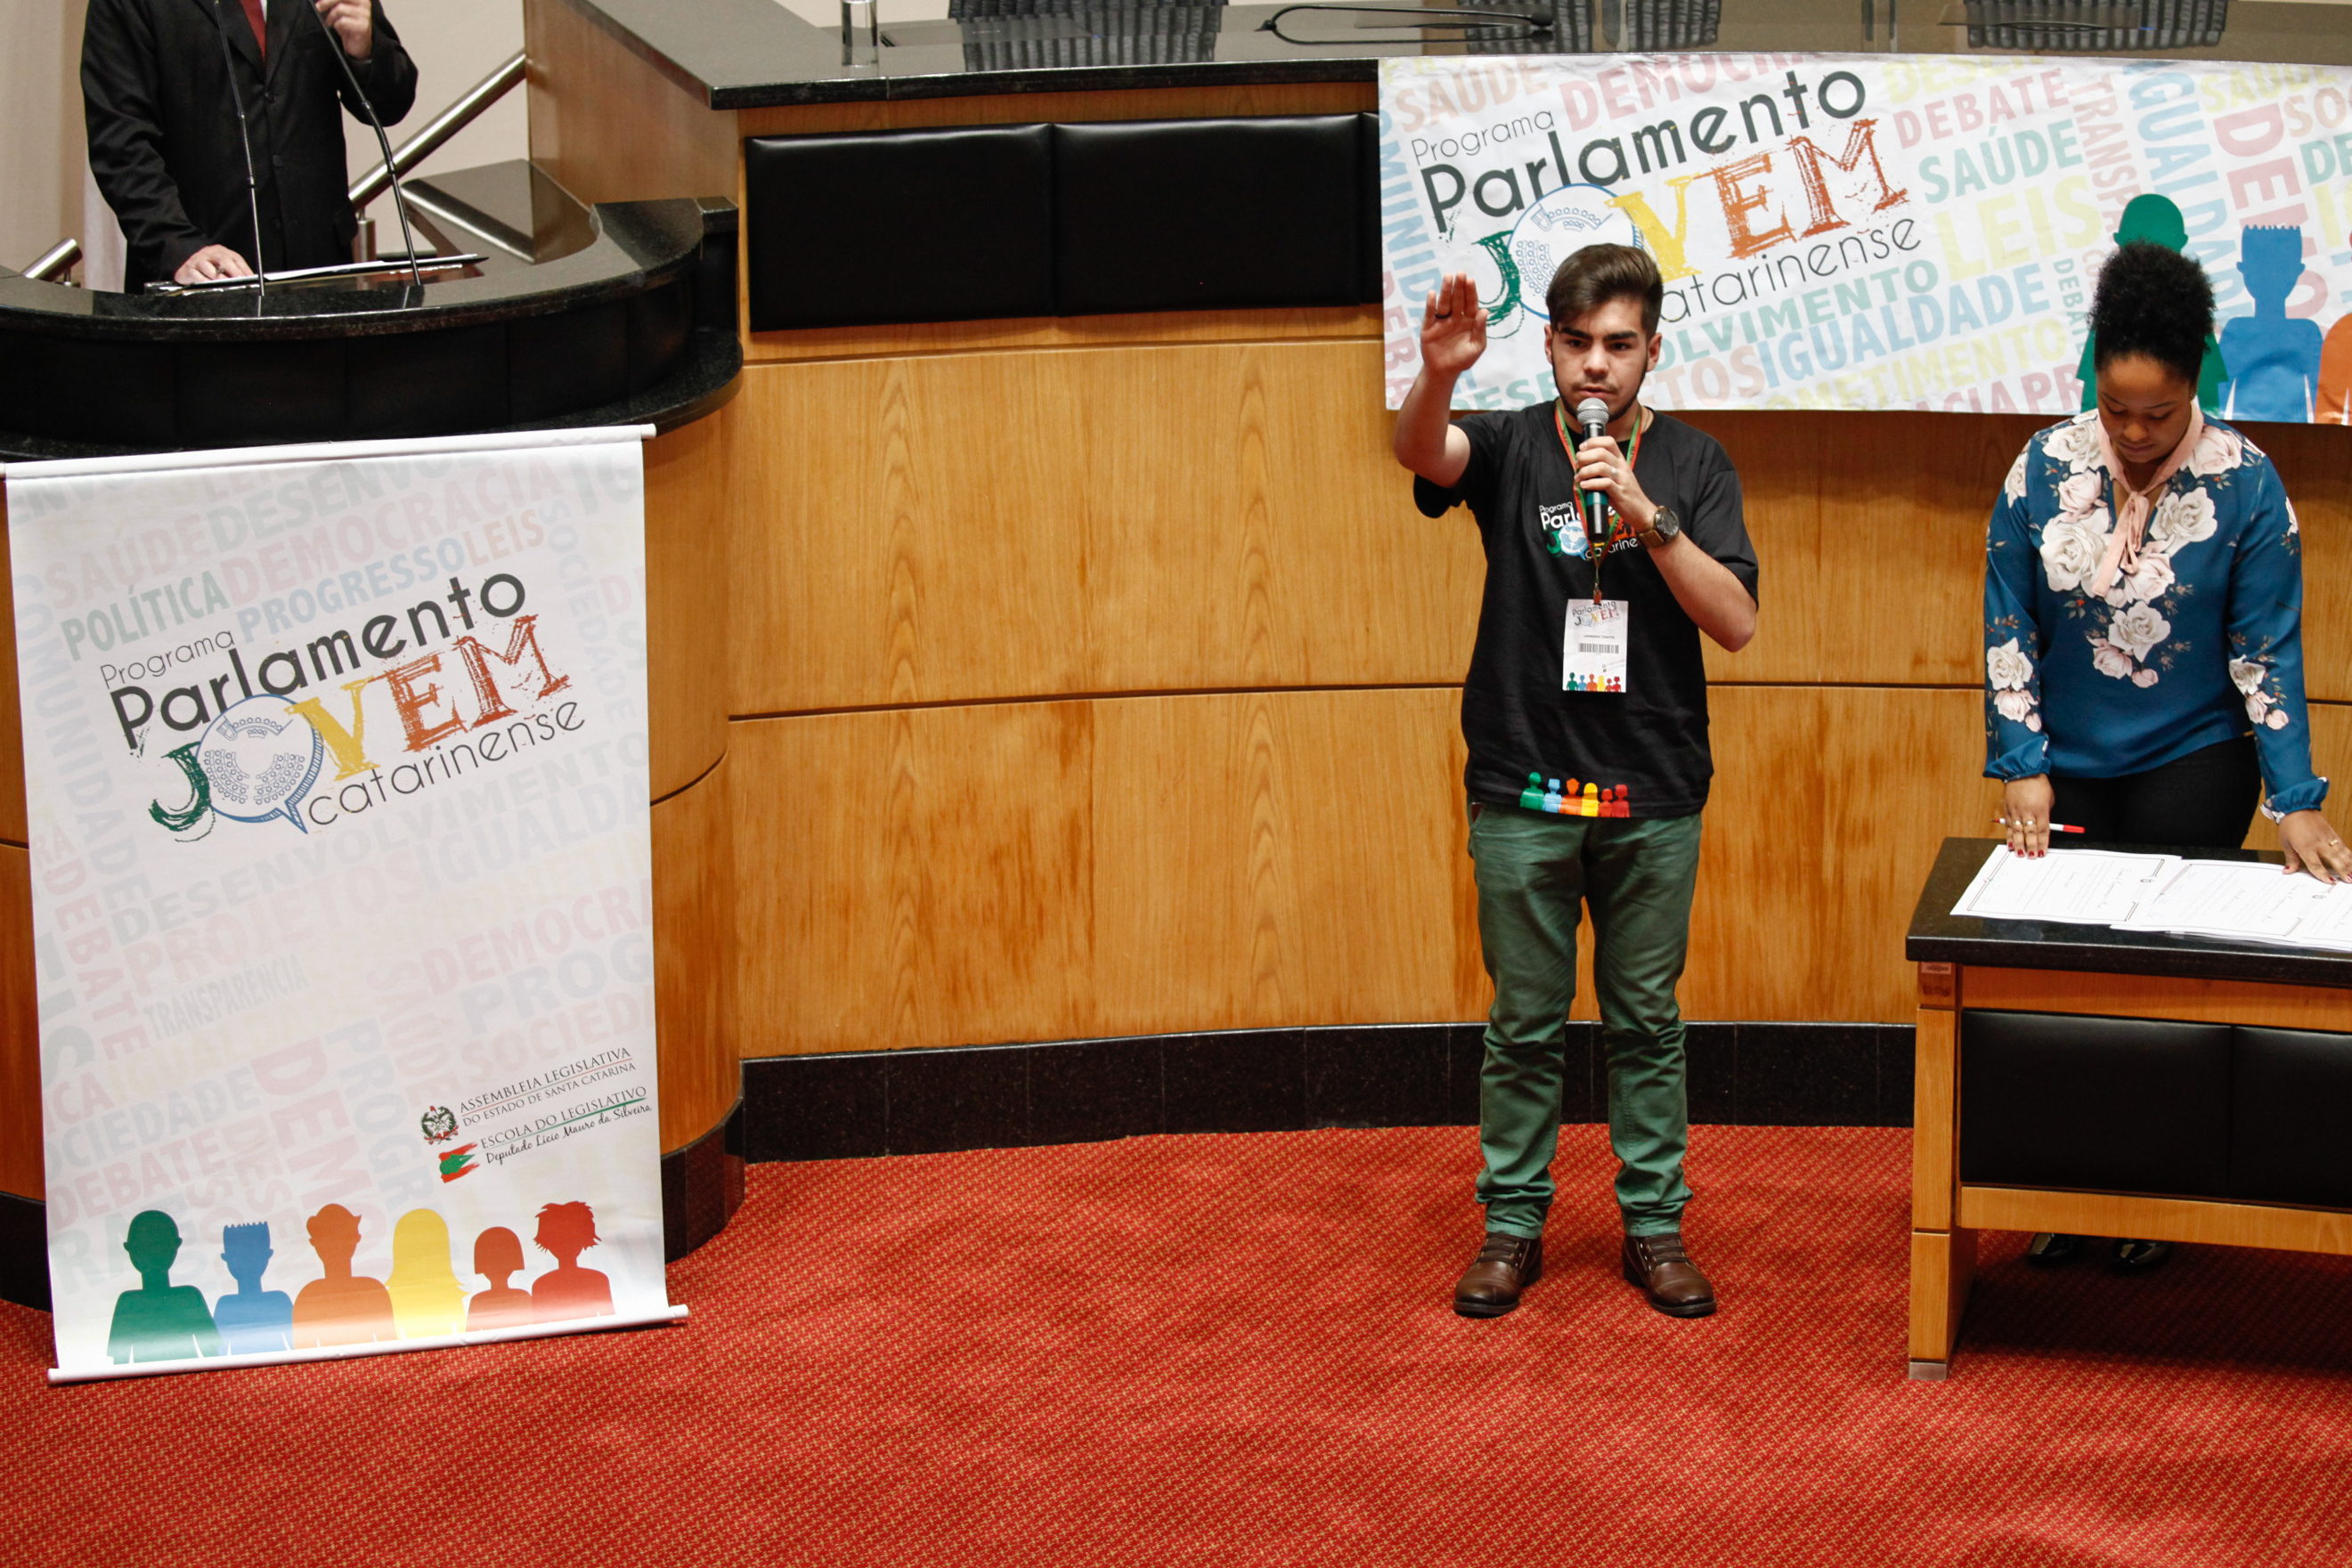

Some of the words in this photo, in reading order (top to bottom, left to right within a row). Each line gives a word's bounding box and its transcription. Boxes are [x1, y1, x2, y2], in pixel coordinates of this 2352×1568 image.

[1411, 110, 1555, 167] Programa
[1420, 69, 1867, 235] Parlamento
[1892, 68, 2071, 150] DEBATE
[1918, 118, 2083, 204] SAÚDE
[1660, 217, 1921, 323] atarinense
[1933, 175, 2102, 281] LEIS
[1756, 263, 2050, 388] IGUALDADE
[61, 571, 231, 662] POLÍTICA
[220, 454, 566, 606] DEMOCRACIA
[1539, 501, 1573, 514] Programa
[236, 537, 465, 644] PROGRESSO
[462, 508, 545, 567] LEIS
[538, 500, 637, 726] SOCIEDADE
[1572, 601, 1616, 616] Parlamento
[100, 630, 236, 690] Programa
[110, 573, 525, 752] Parlamento
[308, 701, 586, 825] catarinense
[43, 857, 151, 1060] DEBATE
[123, 847, 425, 998] PROJETOS
[143, 953, 311, 1041] TRANSPARÊNCIA
[460, 1076, 541, 1114] ASSEMBLEIA
[544, 1047, 631, 1086] LEGISLATIVA
[463, 1113, 481, 1127] DO
[484, 1099, 525, 1121] ESTADO
[528, 1093, 543, 1106] DE
[545, 1080, 581, 1100] SANTA
[581, 1061, 637, 1086] CATARINA
[480, 1123, 533, 1150] ESCOLA
[534, 1114, 557, 1132] DO
[559, 1085, 647, 1122] LEGISLATIVO
[46, 1127, 226, 1231] DEBATE
[486, 1141, 533, 1166] Deputado
[535, 1131, 559, 1148] Lício
[562, 1121, 595, 1139] Mauro
[598, 1112, 612, 1125] da
[613, 1103, 652, 1121] Silveira
